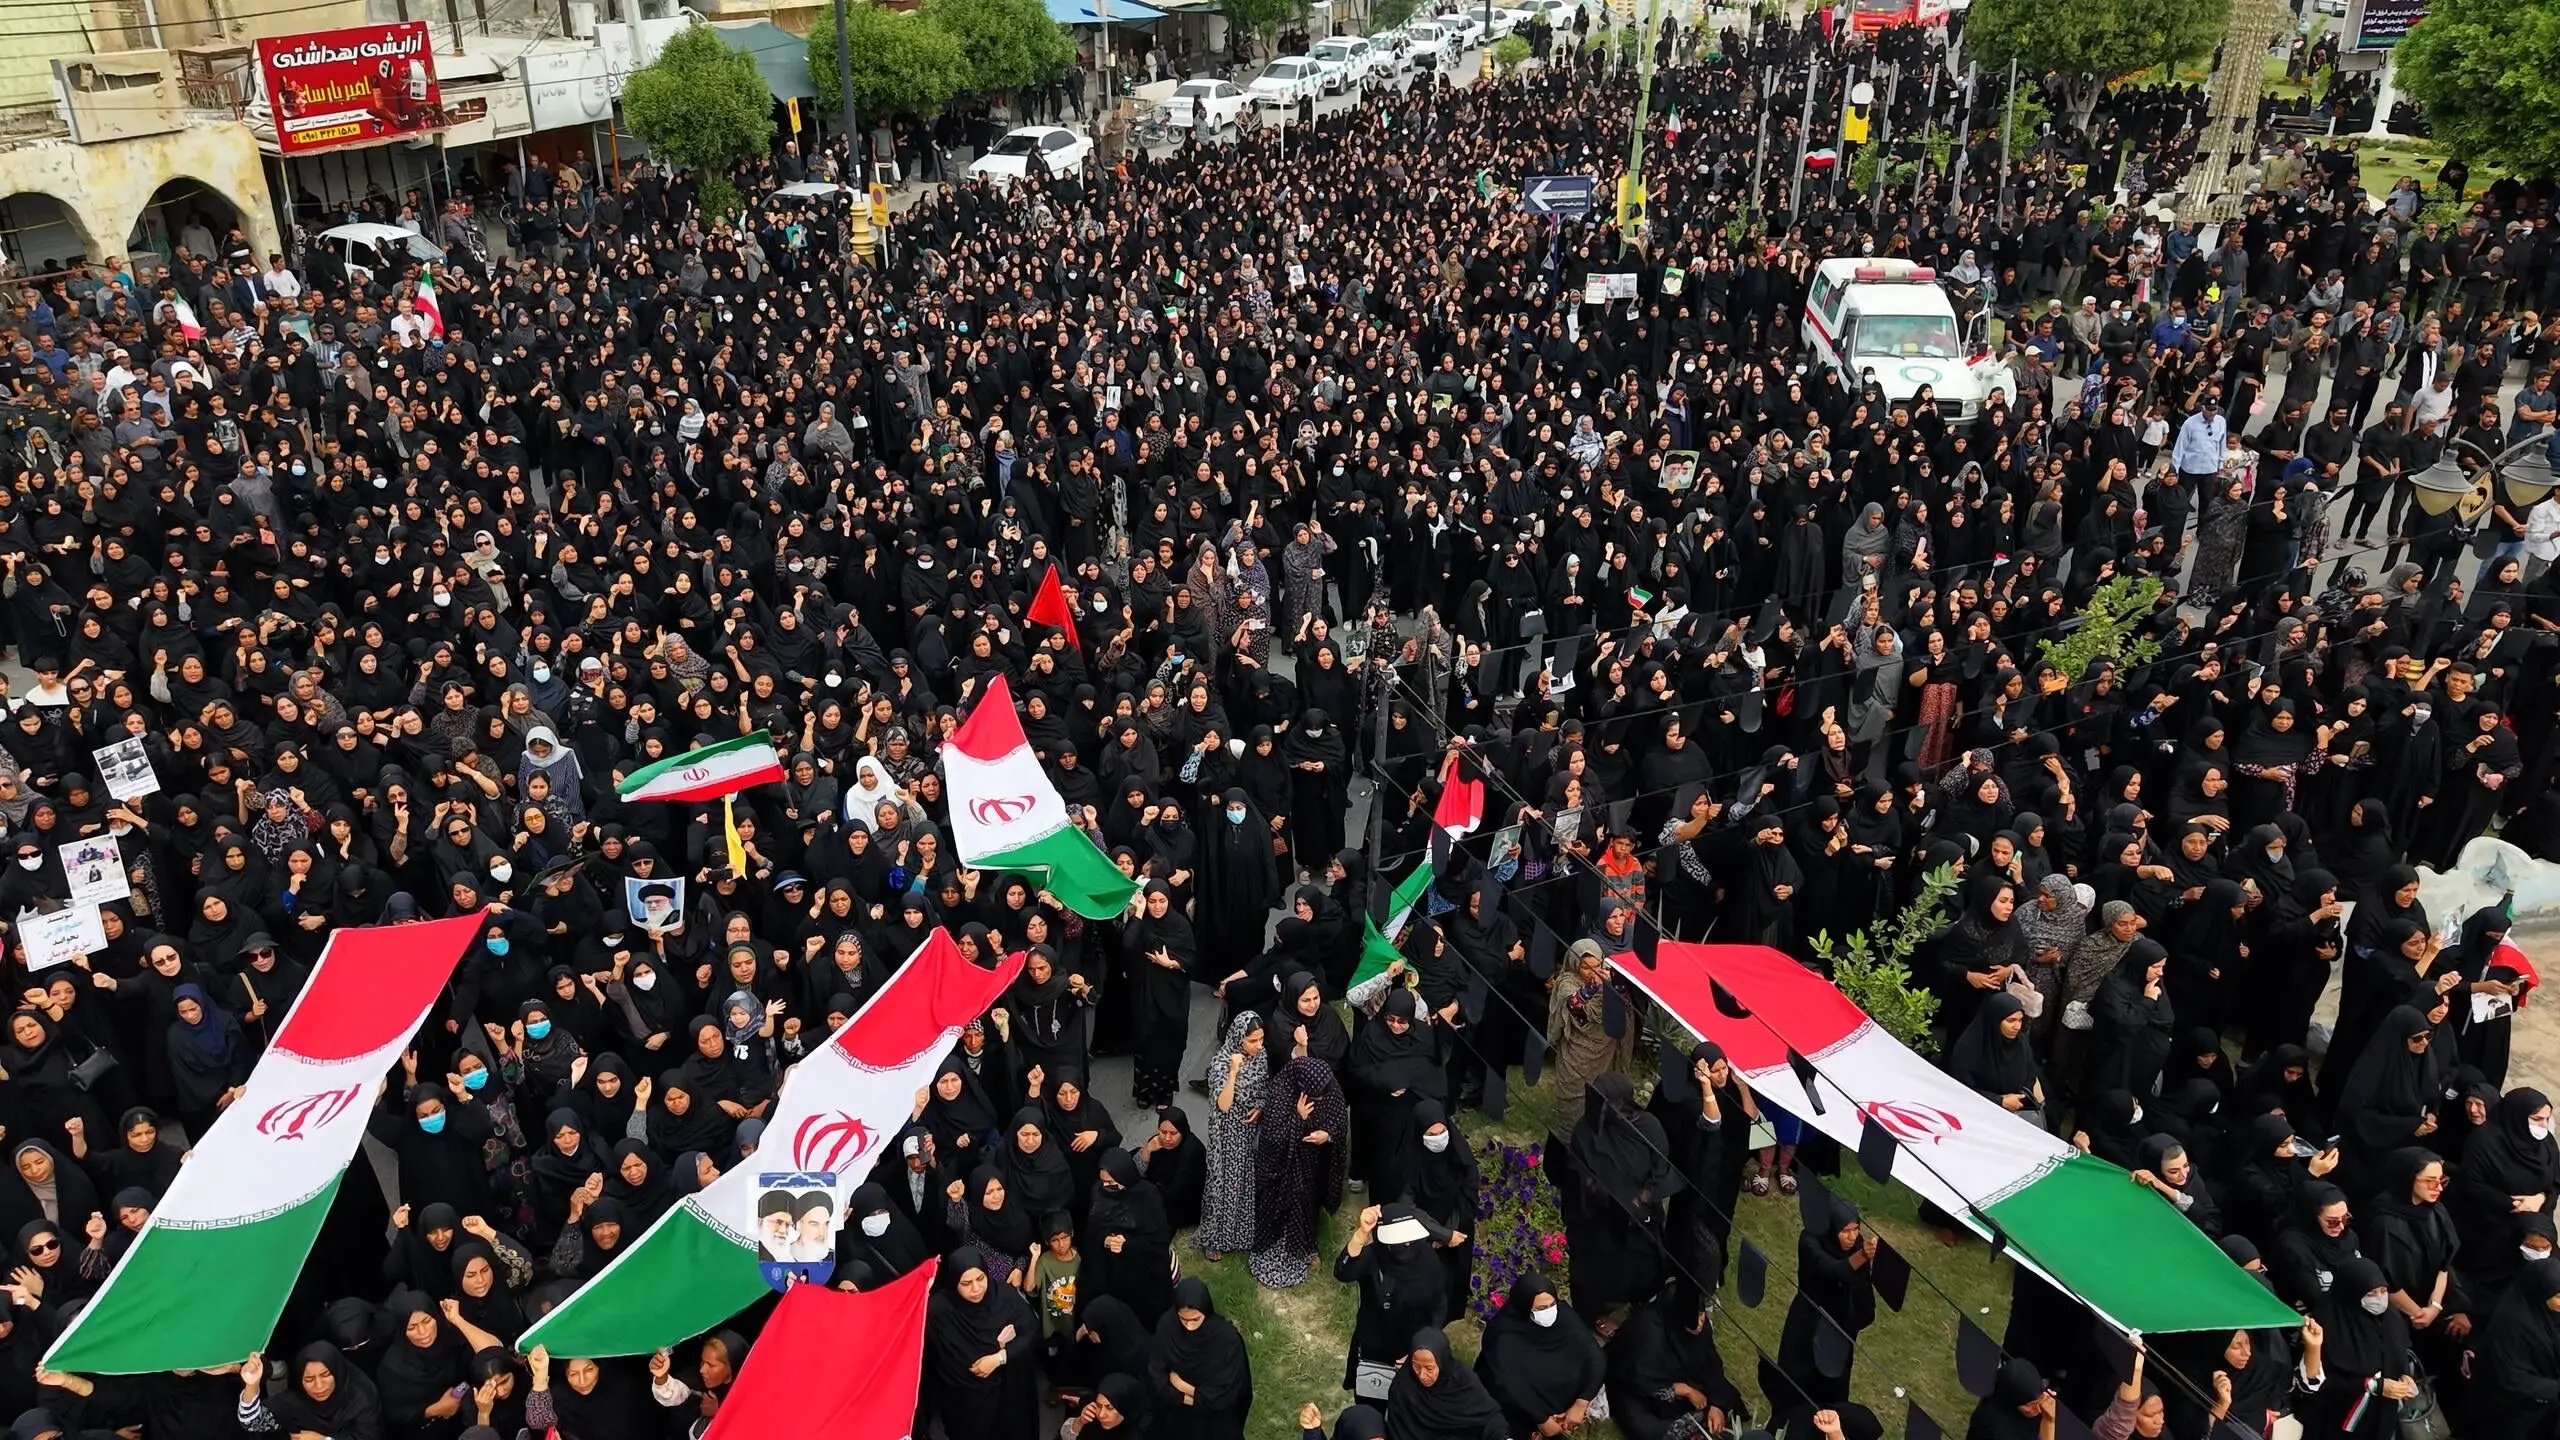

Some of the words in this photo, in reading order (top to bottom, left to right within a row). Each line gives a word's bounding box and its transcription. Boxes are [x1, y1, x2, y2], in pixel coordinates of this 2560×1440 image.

[272, 41, 359, 68] بهداشتی
[360, 31, 424, 59] آرایشی
[345, 75, 372, 101] امیر
[338, 127, 357, 135] ۱۵۸۰
